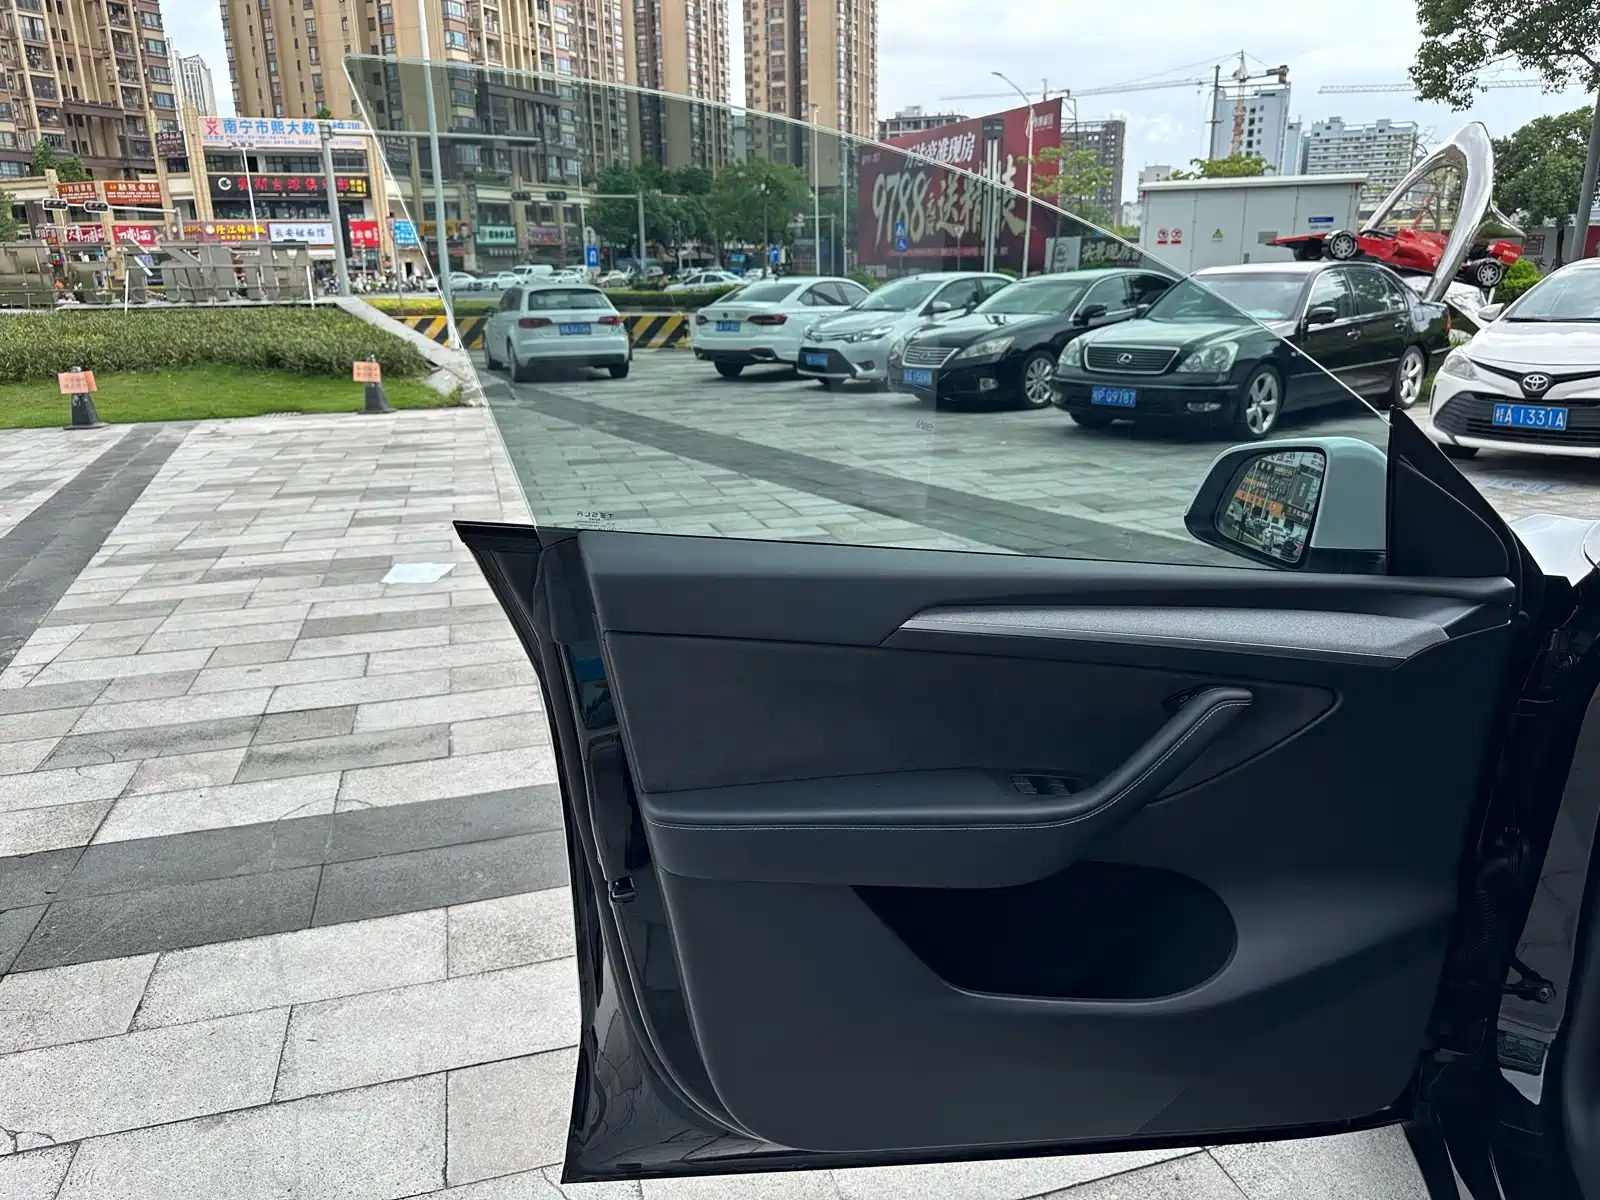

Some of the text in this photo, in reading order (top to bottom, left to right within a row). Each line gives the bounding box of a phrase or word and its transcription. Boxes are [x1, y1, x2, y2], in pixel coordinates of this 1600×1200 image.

[223, 118, 360, 136] 南宁市熙大教培训
